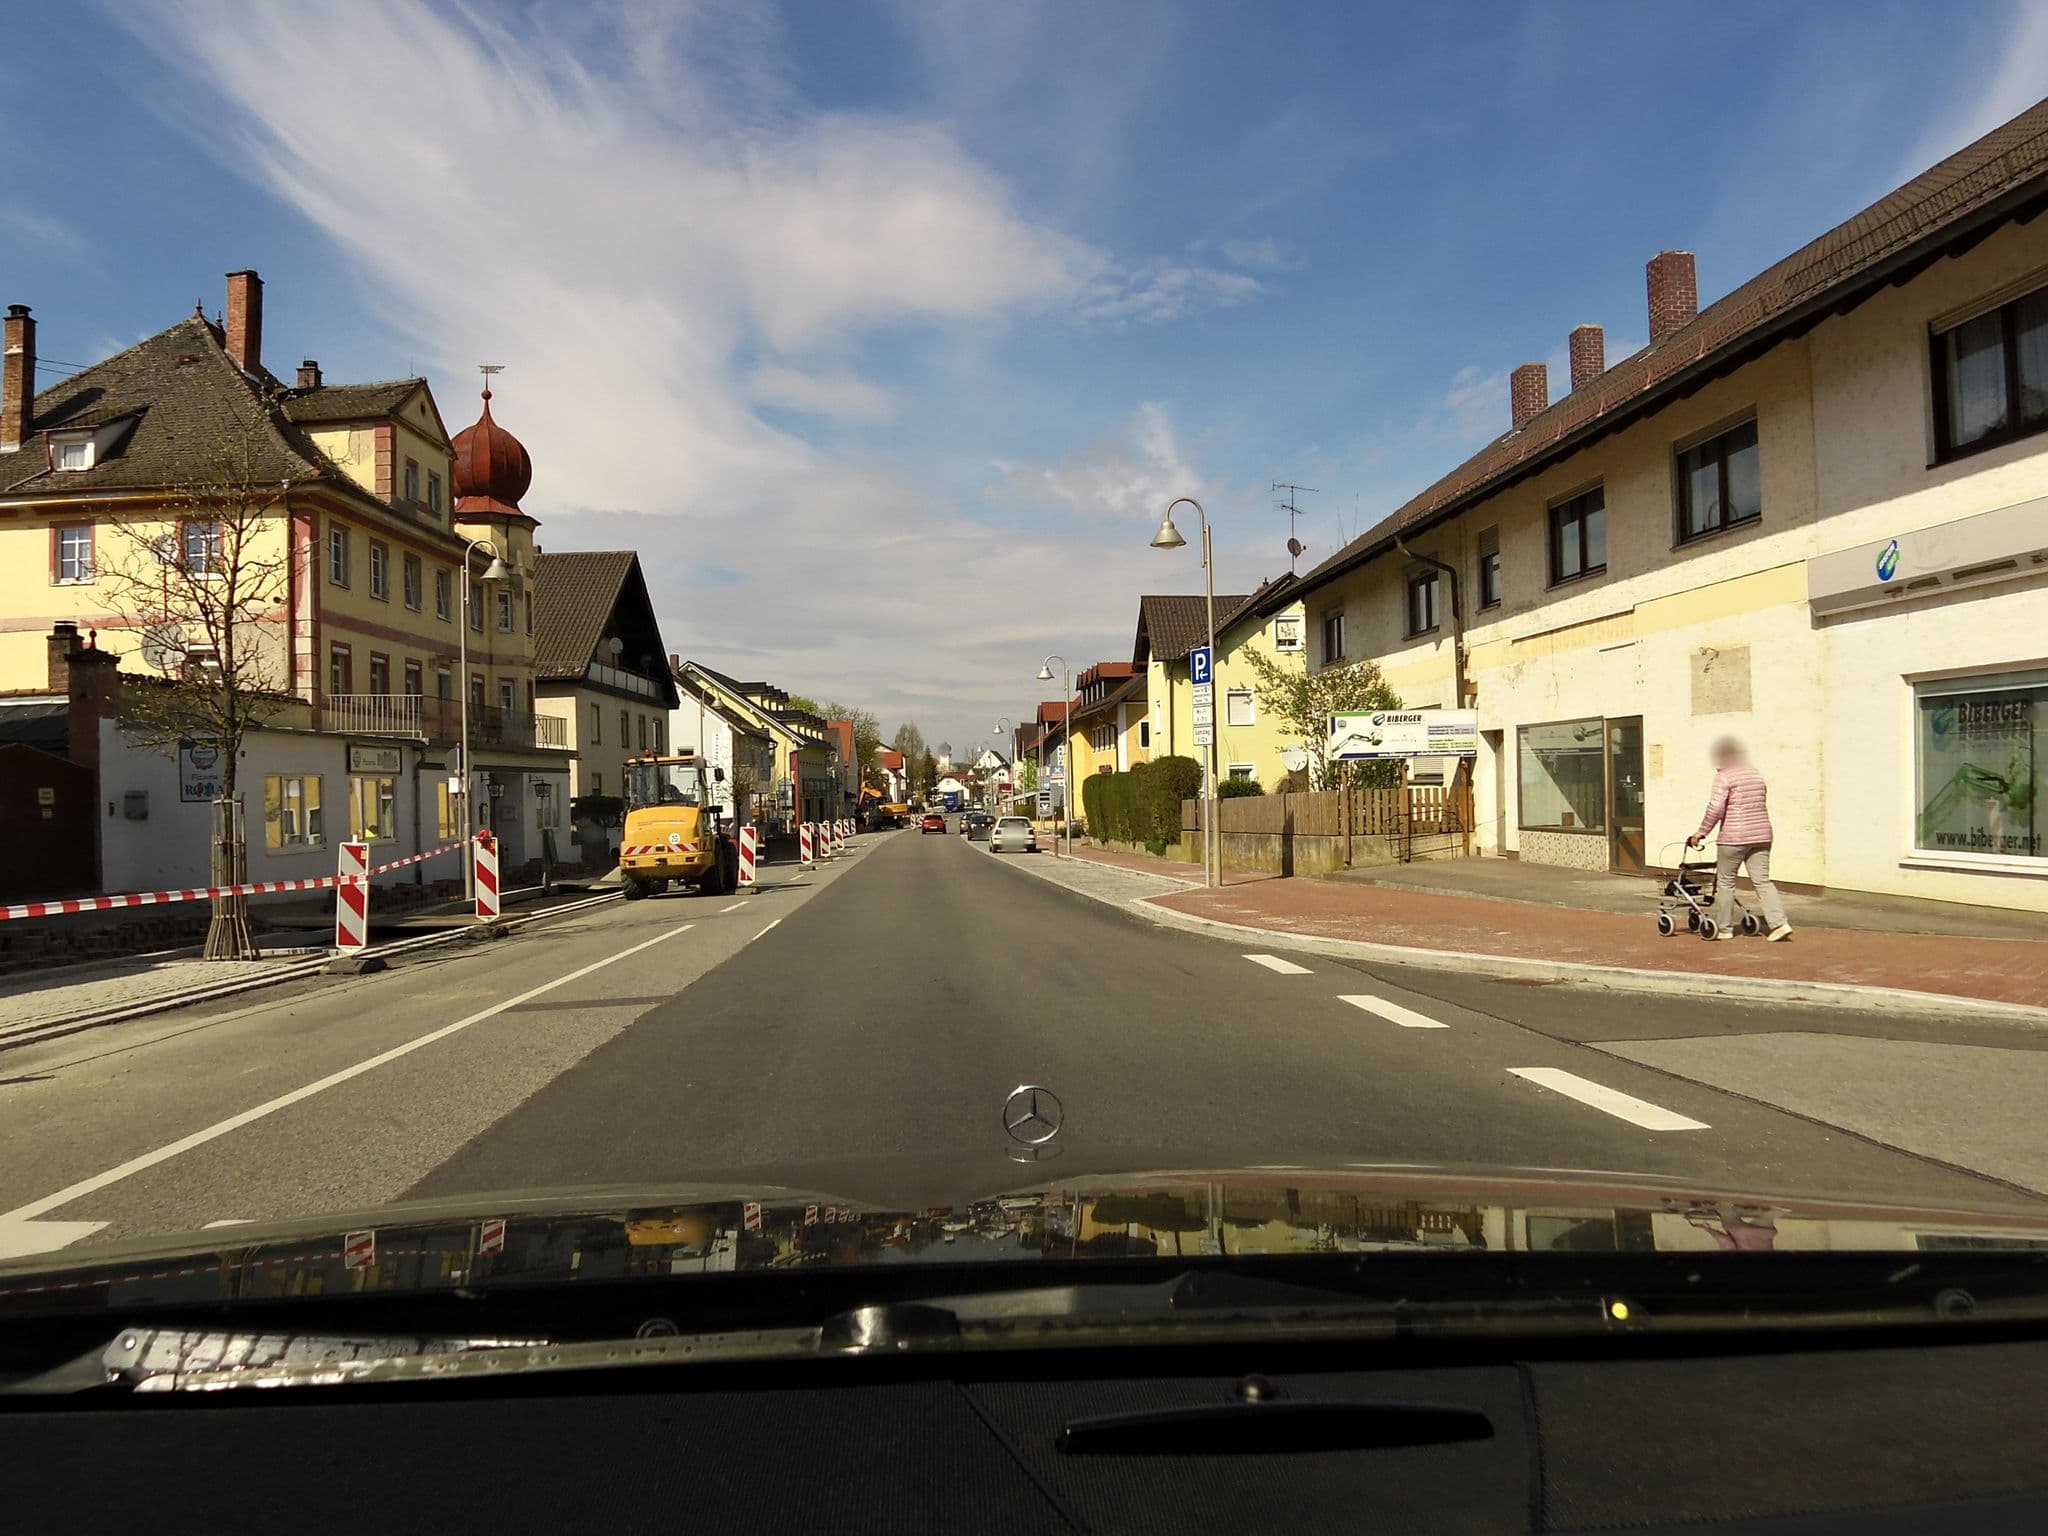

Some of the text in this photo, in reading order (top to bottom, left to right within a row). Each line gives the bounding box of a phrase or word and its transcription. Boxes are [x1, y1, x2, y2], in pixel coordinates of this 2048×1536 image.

[1195, 653, 1206, 680] P
[1387, 714, 1422, 722] BIBERGER
[1959, 699, 2029, 724] BIBERGER
